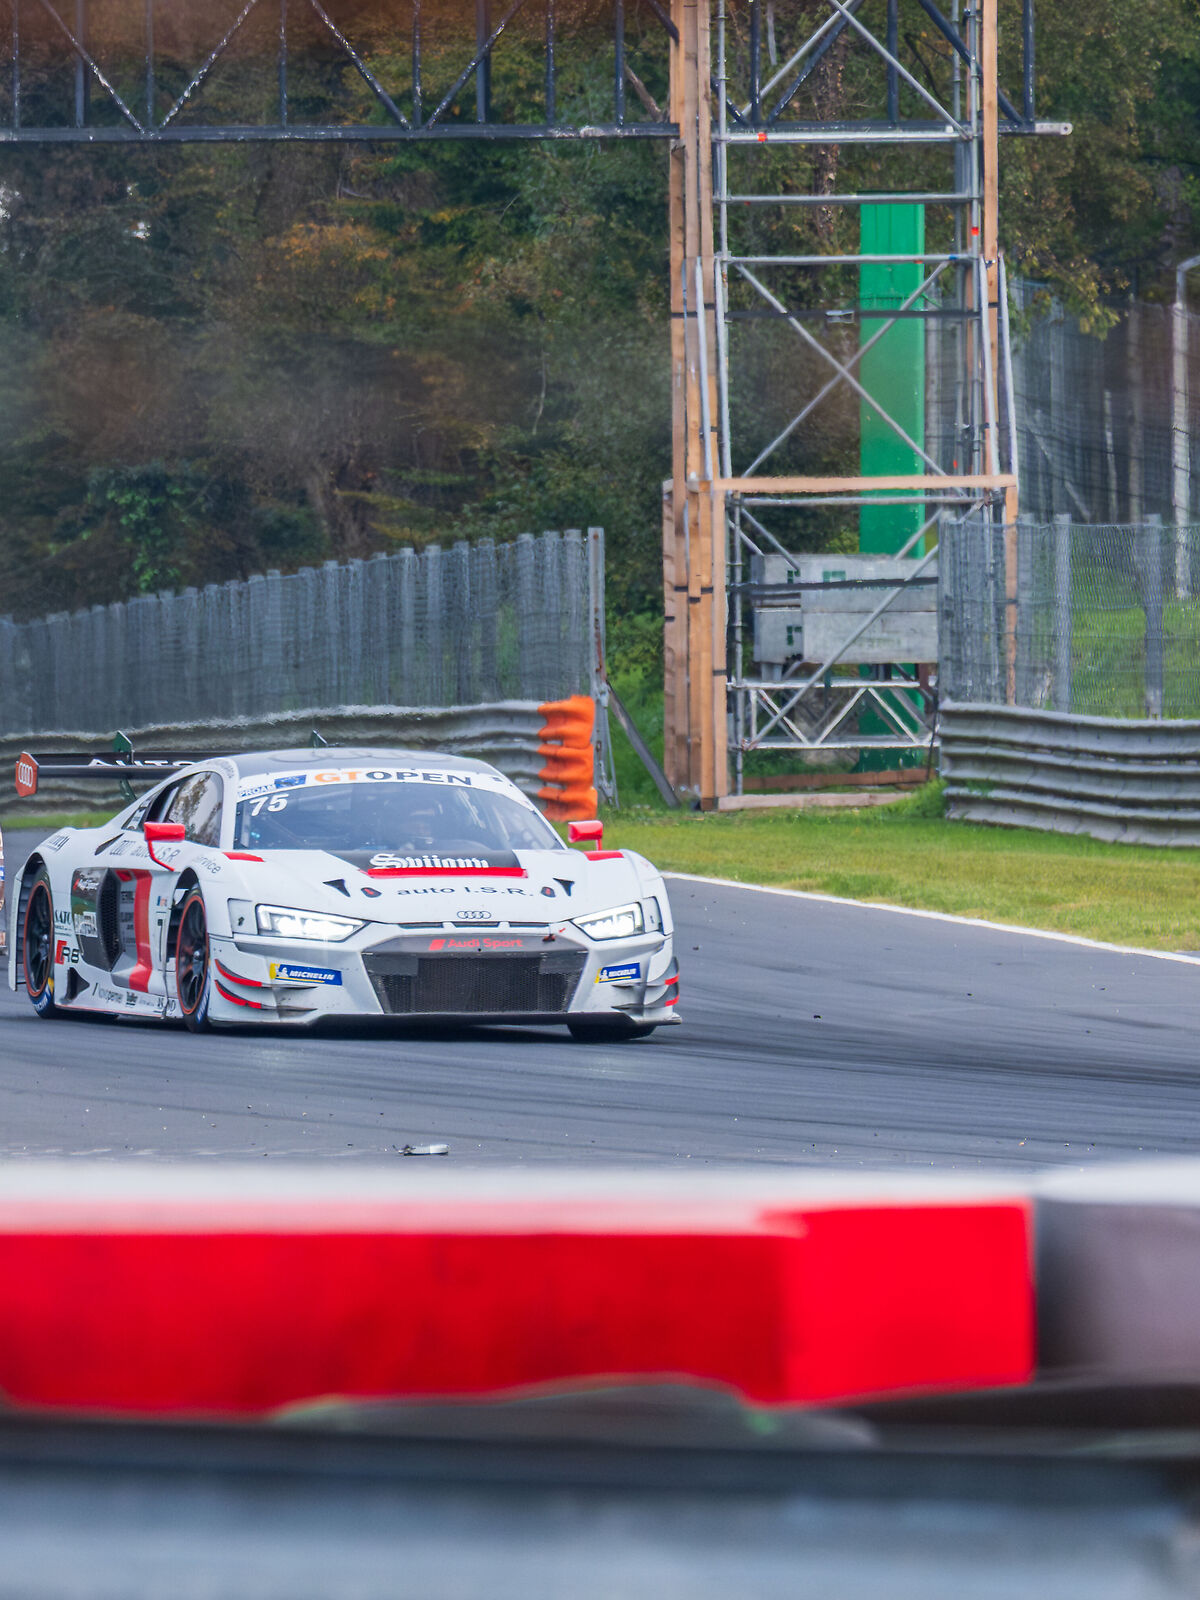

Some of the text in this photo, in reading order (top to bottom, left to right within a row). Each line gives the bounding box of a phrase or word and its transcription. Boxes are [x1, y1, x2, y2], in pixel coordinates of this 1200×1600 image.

[249, 793, 289, 816] 75
[397, 886, 455, 896] auto
[447, 938, 523, 950] Audi Sport
[289, 969, 335, 981] MICHELIN
